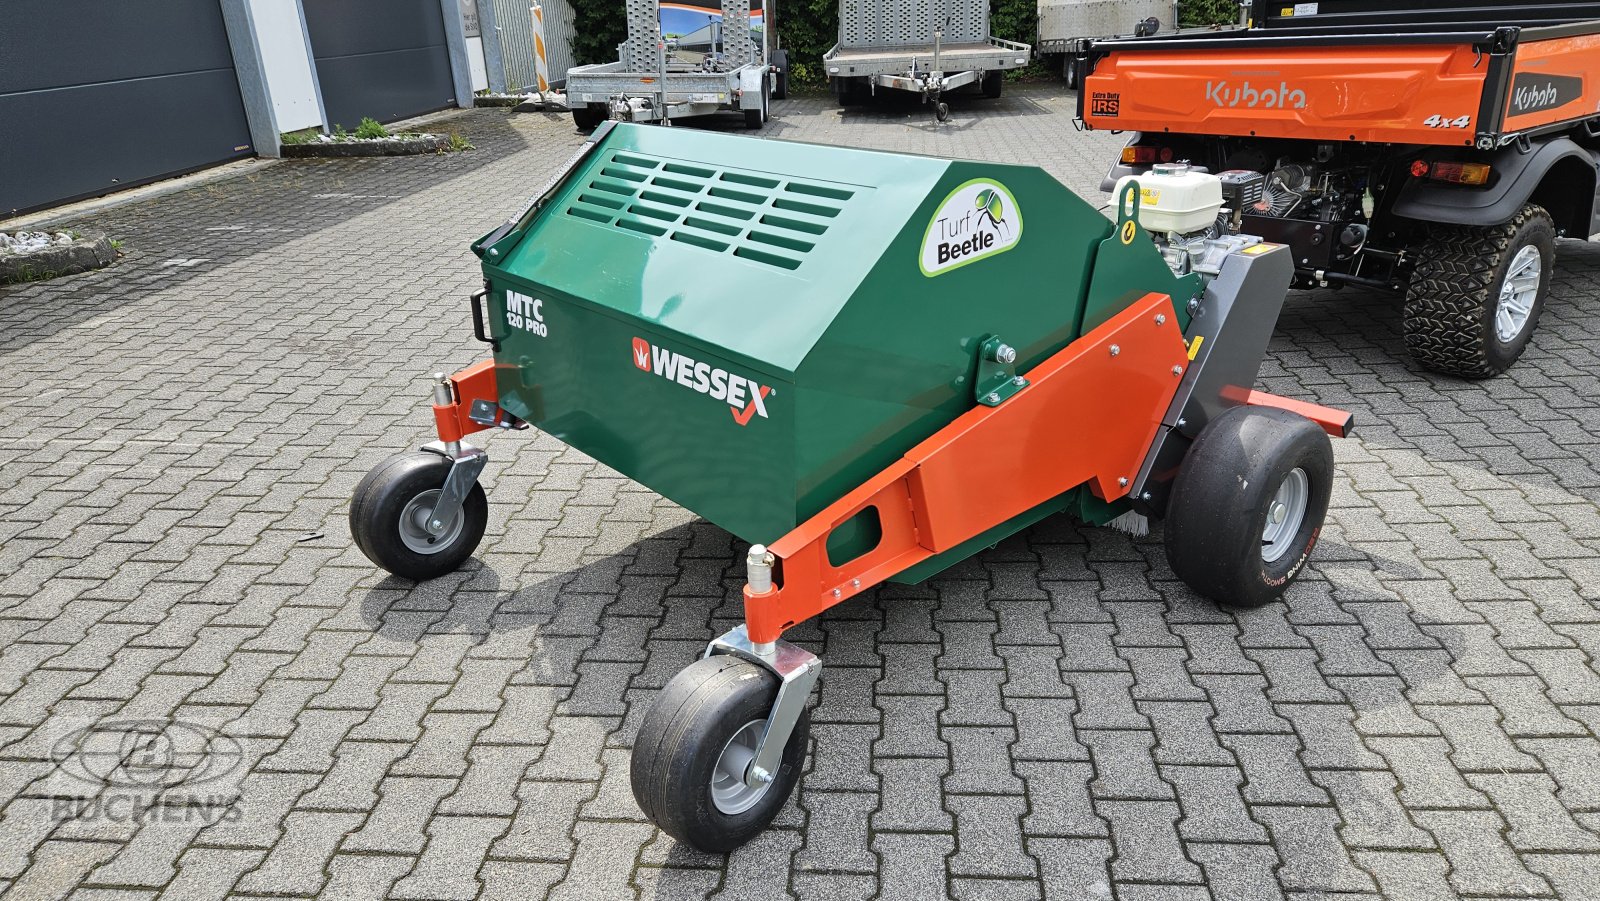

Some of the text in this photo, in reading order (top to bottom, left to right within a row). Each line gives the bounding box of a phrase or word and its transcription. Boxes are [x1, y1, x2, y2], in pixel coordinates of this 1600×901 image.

[1092, 101, 1119, 113] IRS
[1205, 81, 1306, 108] Kubota
[1514, 83, 1557, 111] Kubota
[1423, 114, 1471, 129] 4x4
[937, 210, 971, 241] Turf
[937, 230, 994, 265] Beetle
[506, 289, 544, 322] MTC
[506, 311, 548, 338] 120 PRO
[651, 344, 772, 426] WESSEX
